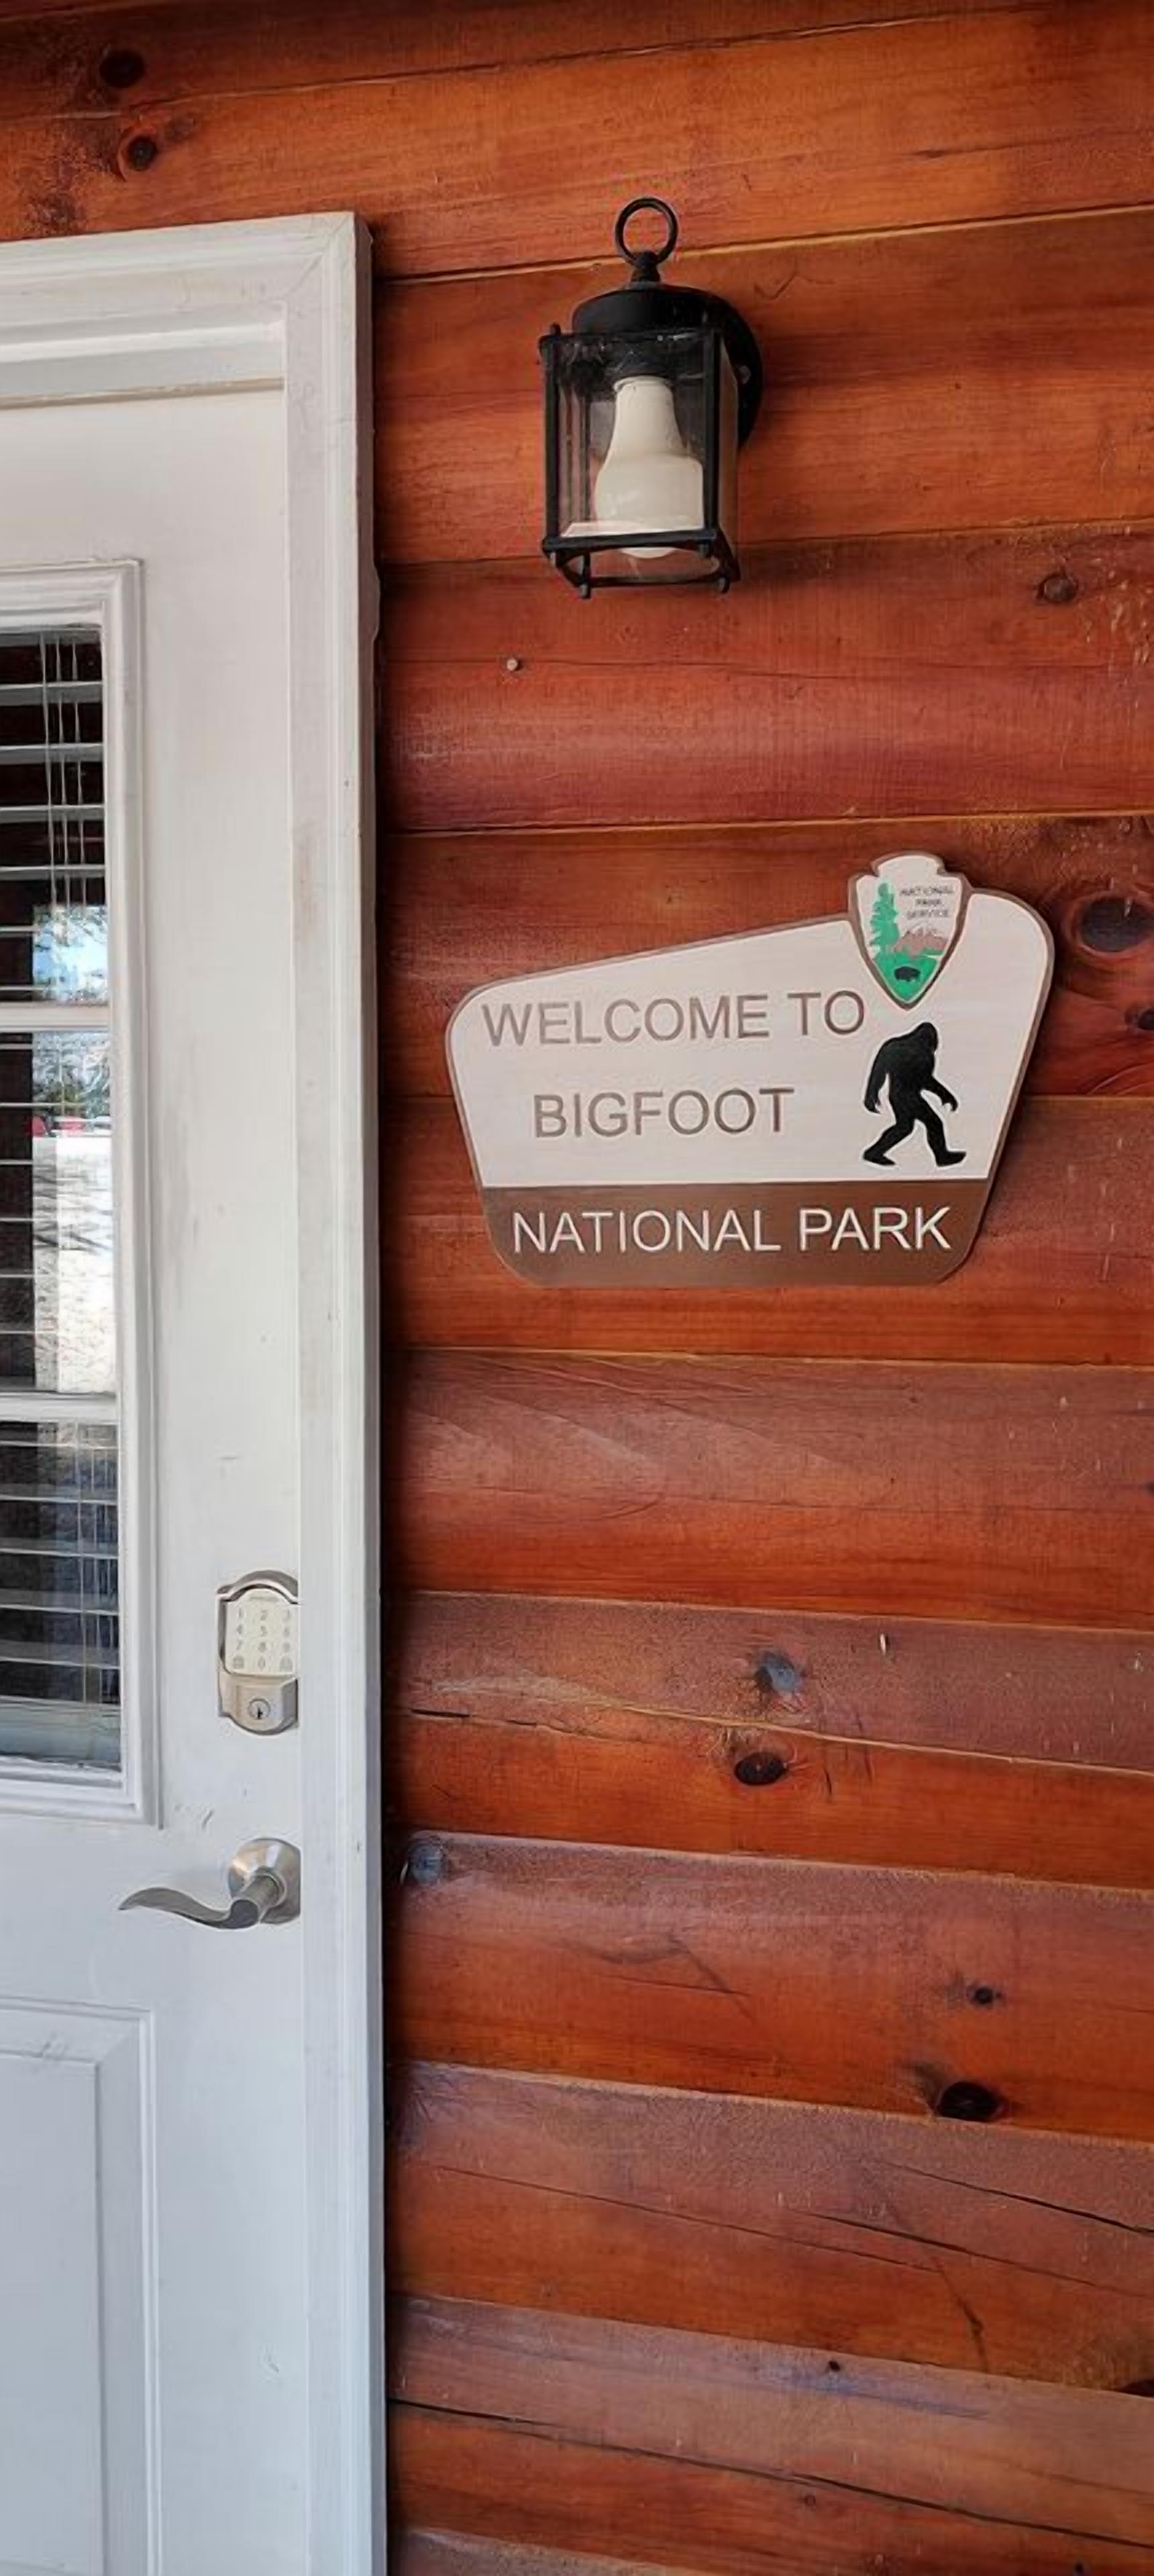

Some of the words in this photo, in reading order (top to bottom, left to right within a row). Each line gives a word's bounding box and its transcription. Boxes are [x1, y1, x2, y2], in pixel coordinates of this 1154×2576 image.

[482, 995, 768, 1046] WELCOME
[788, 990, 864, 1034] TO
[534, 1087, 794, 1138] BIGFOOT
[513, 1210, 780, 1253] NATIONAL
[798, 1206, 951, 1250] PARK
